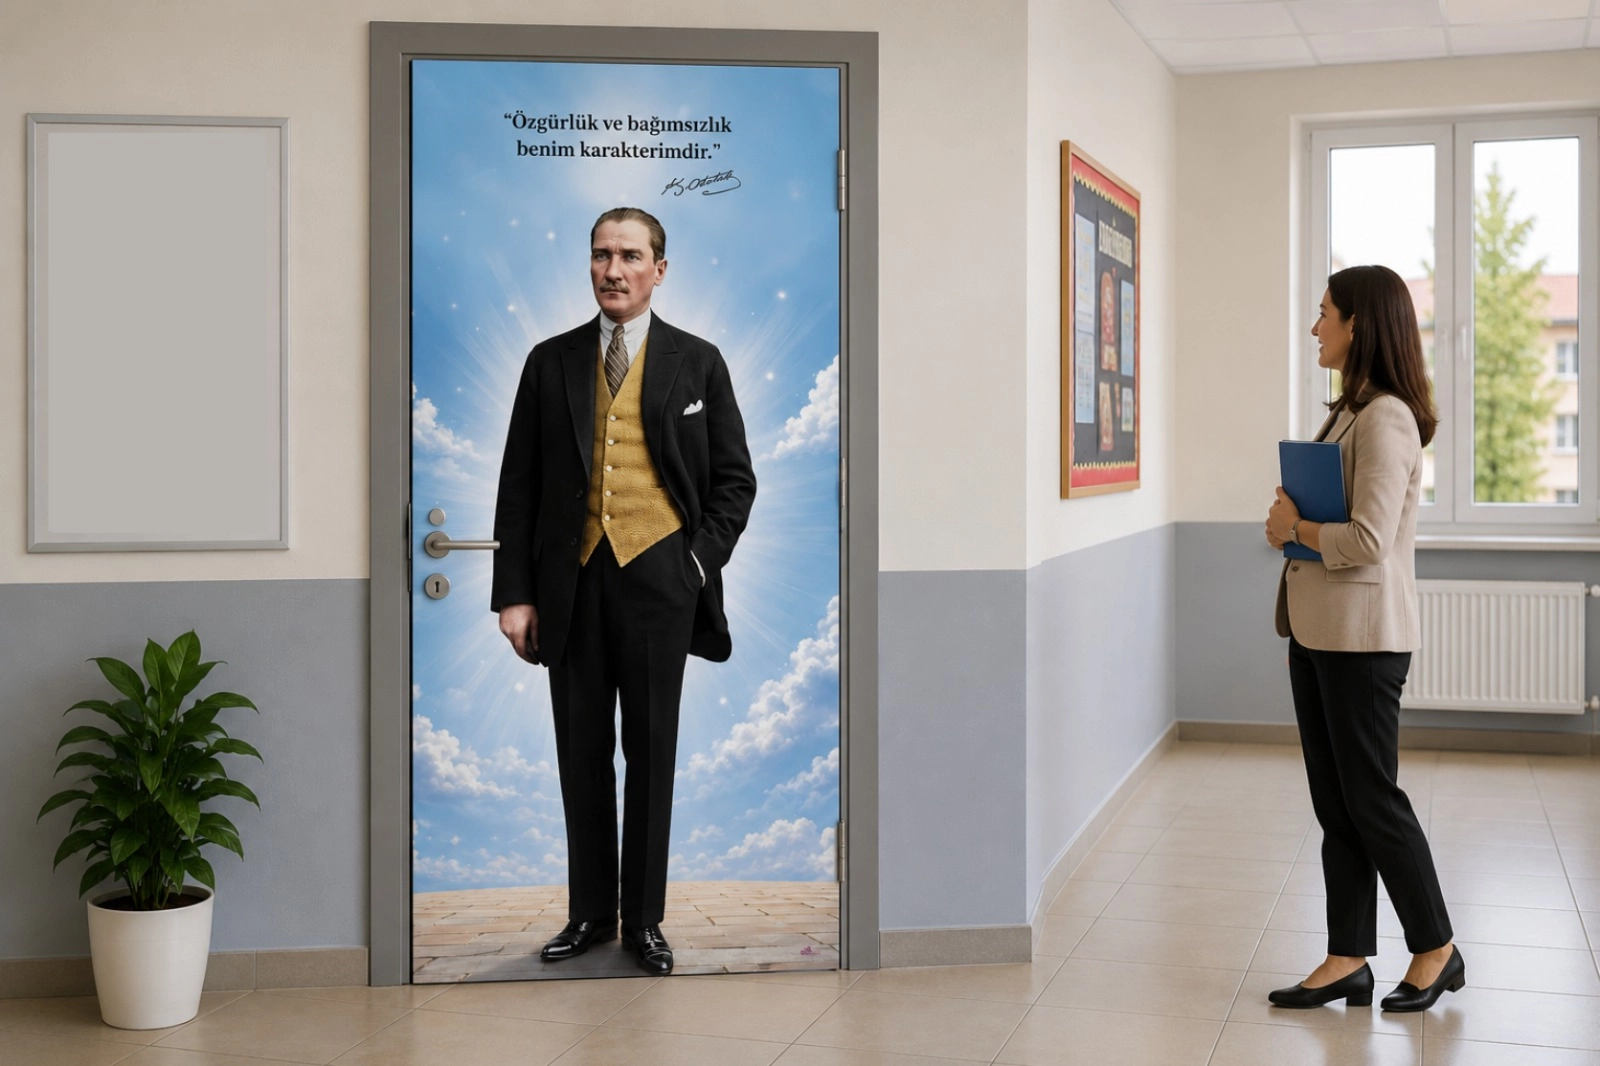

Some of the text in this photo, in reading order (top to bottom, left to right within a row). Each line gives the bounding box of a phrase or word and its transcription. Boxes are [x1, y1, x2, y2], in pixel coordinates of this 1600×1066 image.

[503, 109, 733, 137] “Özgürlük ve bağımsızlık
[516, 139, 721, 160] benim karakterimdir.”
